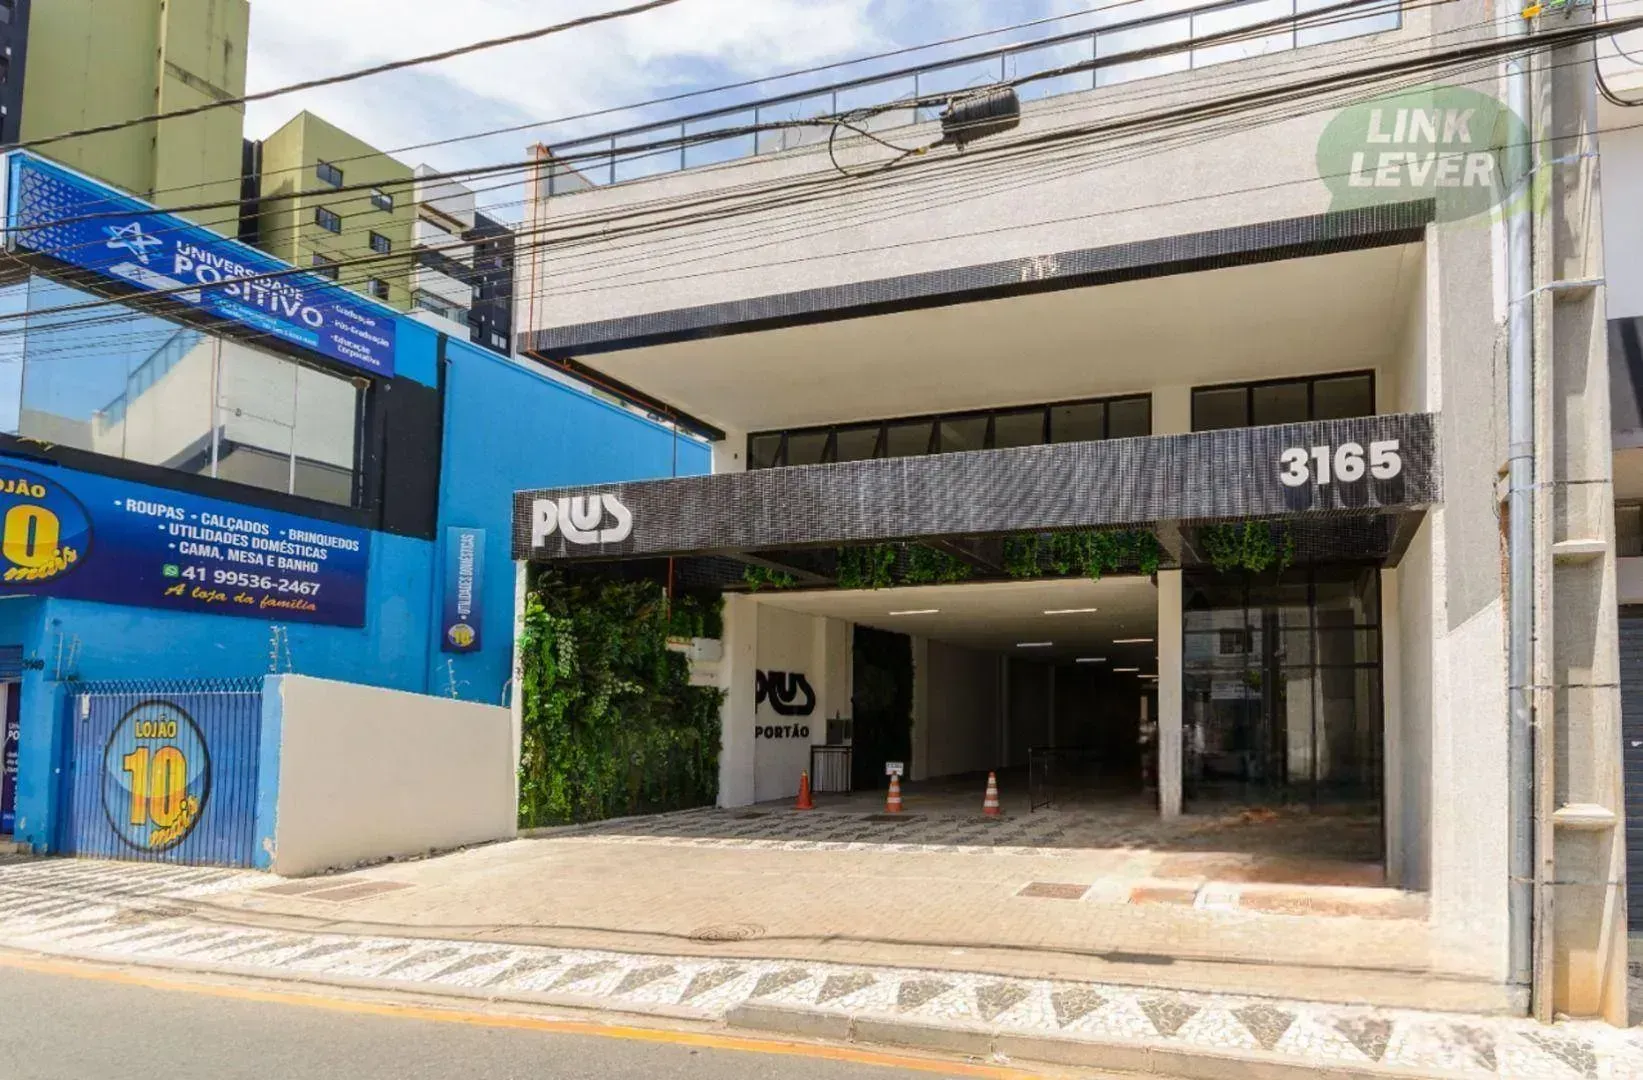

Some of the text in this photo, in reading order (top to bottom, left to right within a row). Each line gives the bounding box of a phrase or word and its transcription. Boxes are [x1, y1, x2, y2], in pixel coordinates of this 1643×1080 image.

[174, 253, 324, 327] POSITIVO
[1280, 439, 1402, 487] 3165
[125, 498, 360, 552] ROUPAS CALÇADOS BRINQUEDOS
[531, 494, 634, 548] PLUS
[168, 523, 328, 561] UTILIDADES DOMÉSTICAS
[182, 565, 321, 596] 41 99536-2467
[227, 549, 264, 567] MESA
[266, 555, 275, 567] E
[278, 557, 319, 574] BANHO
[233, 591, 255, 605] da
[135, 713, 177, 738] LOJÃO
[755, 724, 810, 739] PORTÃO
[123, 746, 187, 828] 10
